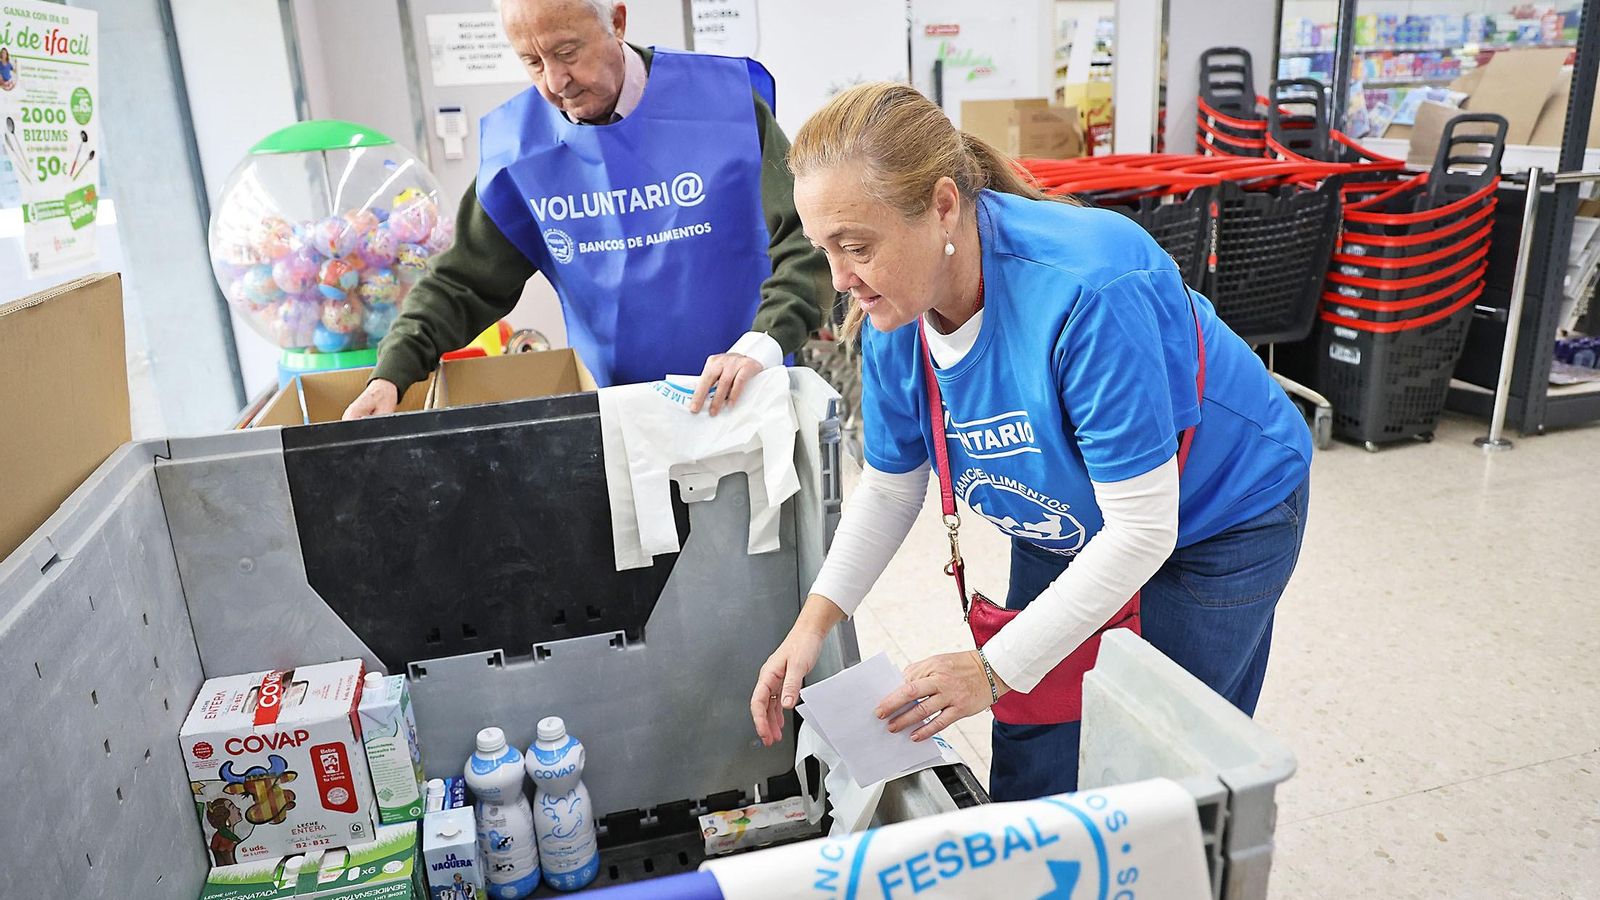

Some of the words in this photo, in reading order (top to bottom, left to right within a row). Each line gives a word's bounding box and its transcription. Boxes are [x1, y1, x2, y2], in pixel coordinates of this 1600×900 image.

[17, 26, 41, 50] de
[44, 28, 89, 56] ifacil
[21, 107, 66, 124] 2000
[23, 129, 68, 142] BIZUMS
[530, 172, 706, 222] VOLUNTARI@
[579, 238, 625, 253] BANCOS
[628, 236, 643, 249] DE
[646, 222, 712, 246] ALIMENTOS
[224, 729, 310, 756] COVAP
[534, 763, 576, 780] COVAP
[432, 859, 473, 872] VAQUERA
[446, 853, 457, 861] LA
[876, 816, 1059, 900] FESBAL
[362, 866, 376, 875] x6
